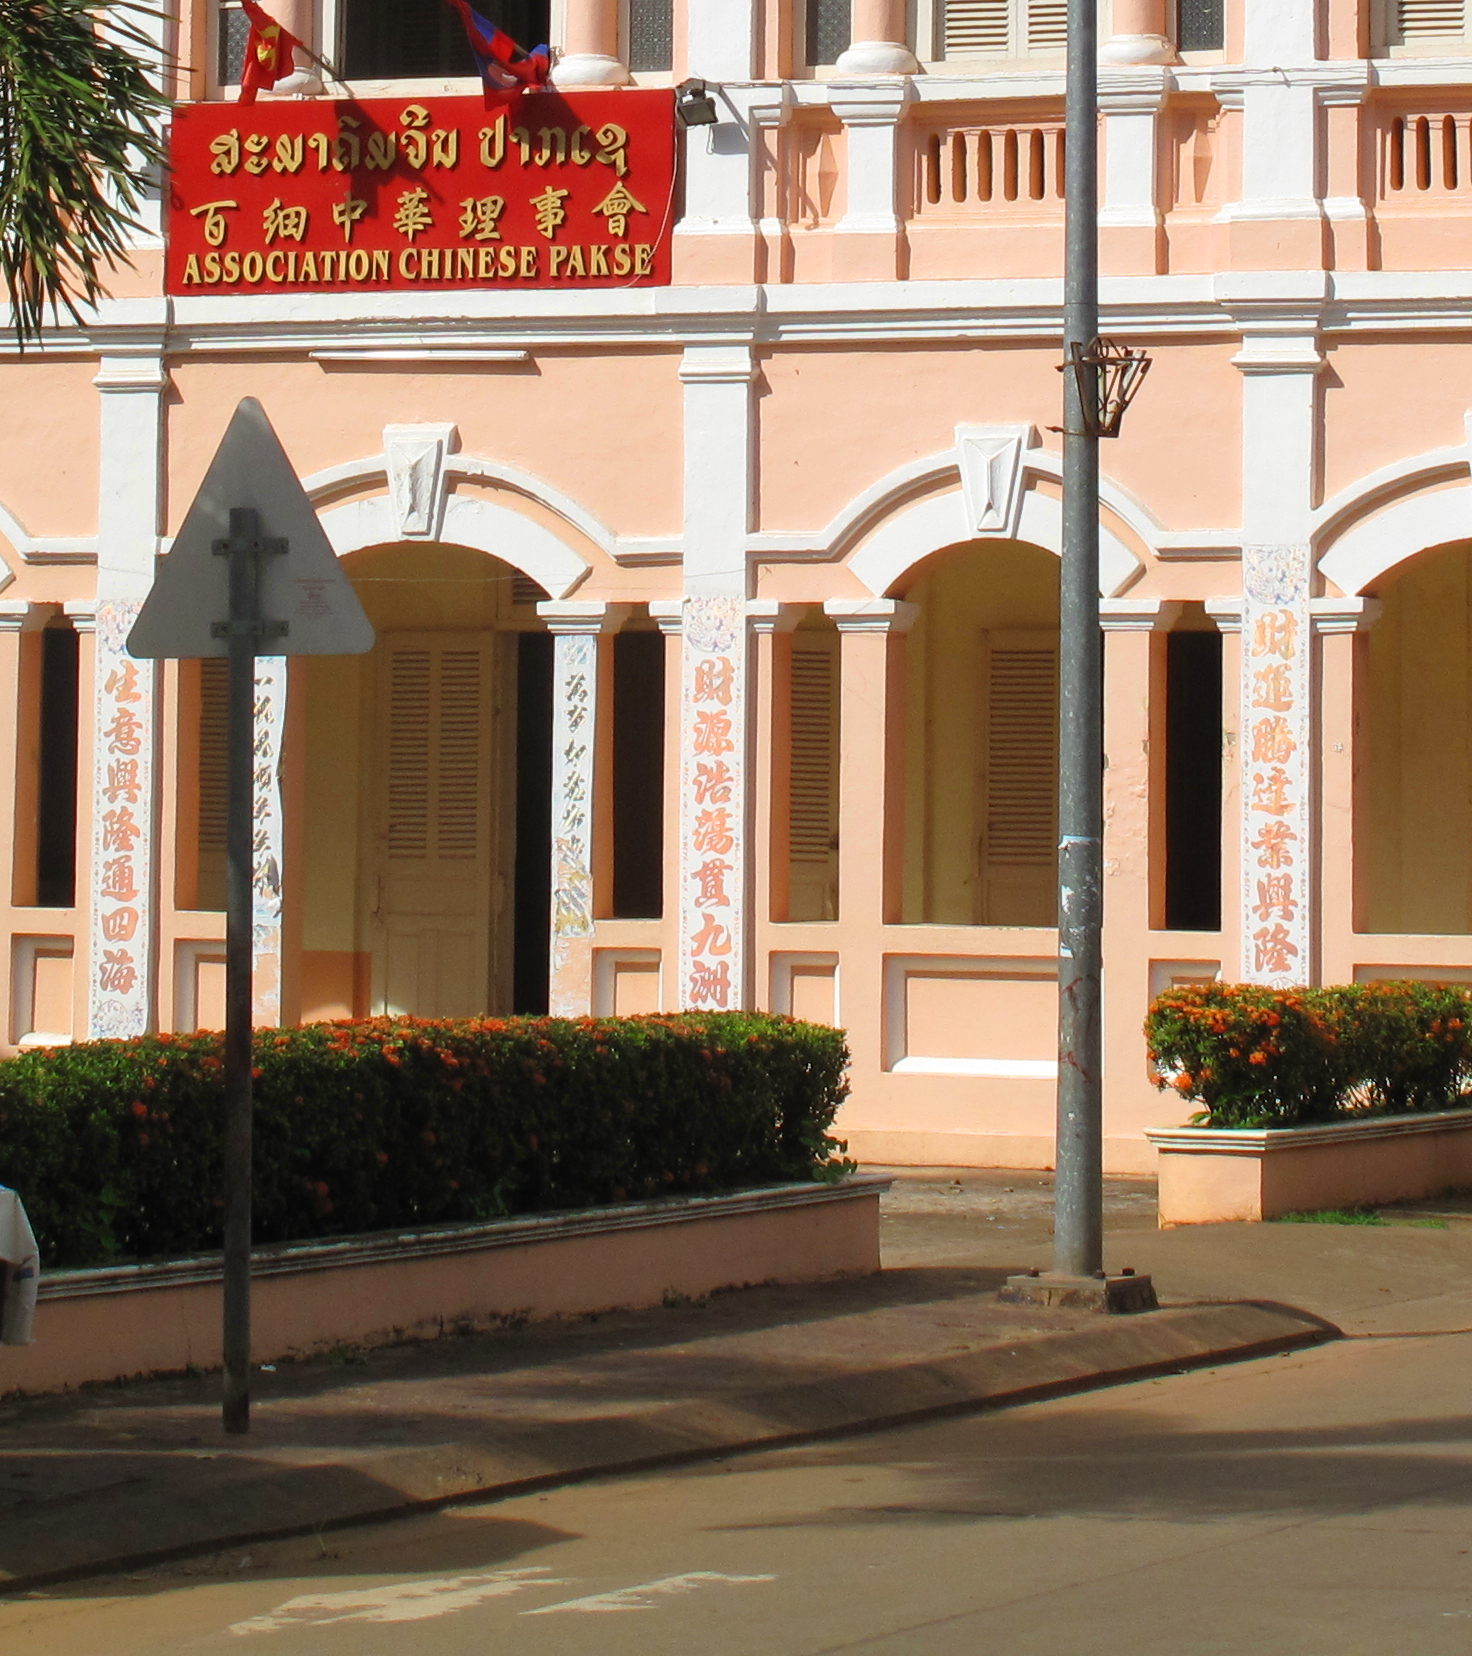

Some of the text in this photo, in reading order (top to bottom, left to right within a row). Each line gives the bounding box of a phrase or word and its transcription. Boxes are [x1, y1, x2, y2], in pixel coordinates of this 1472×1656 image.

[183, 243, 652, 285] ASSOCIATION CHINESE PAKSE
